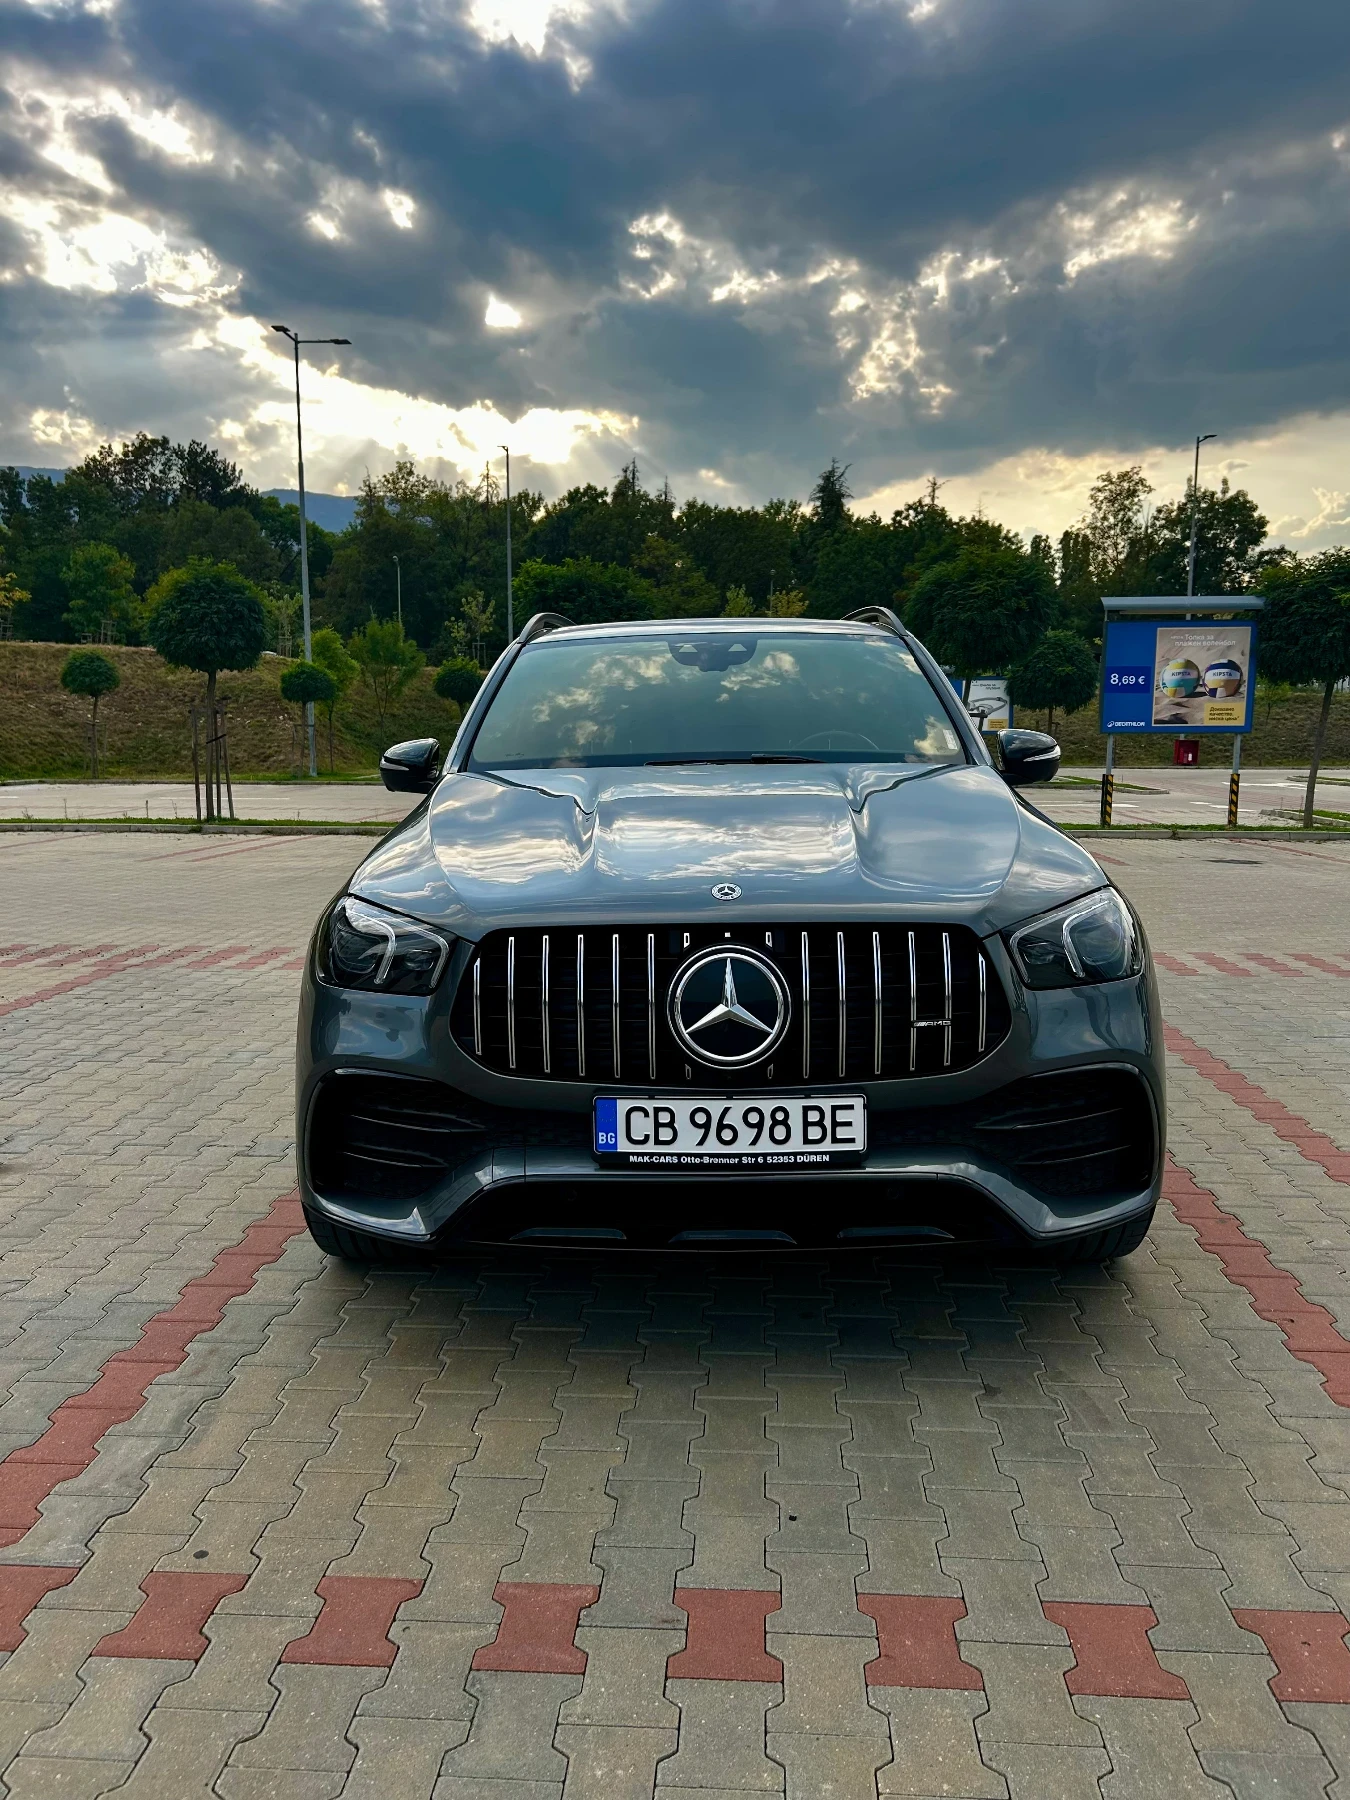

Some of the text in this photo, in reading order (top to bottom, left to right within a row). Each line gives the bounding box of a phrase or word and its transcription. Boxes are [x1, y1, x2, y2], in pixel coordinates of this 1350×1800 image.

[1110, 673, 1146, 686] 8,69 €
[625, 1104, 856, 1146] CB 9698 BE
[598, 1132, 616, 1144] BG
[680, 1155, 740, 1164] Otto-Brenner
[741, 1156, 756, 1164] Str
[757, 1155, 764, 1163] 6
[766, 1155, 795, 1163] 52353
[796, 1153, 830, 1163] DÜREN
